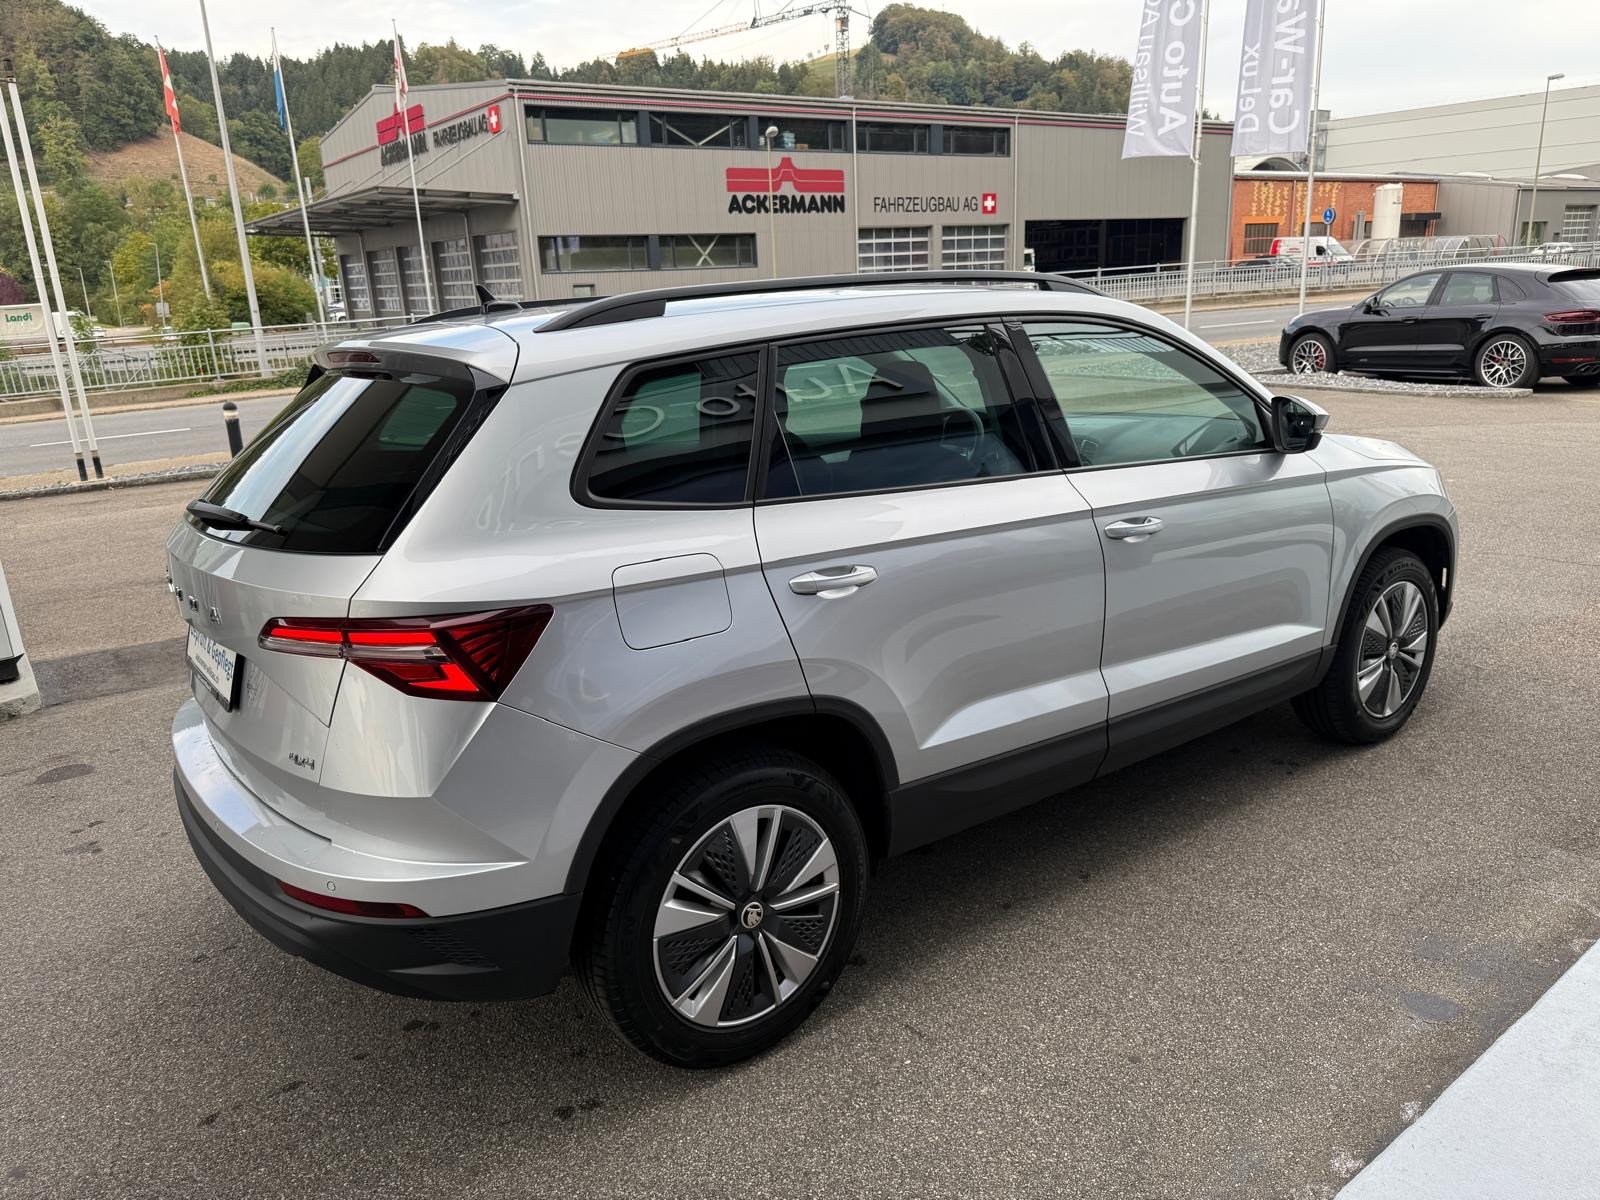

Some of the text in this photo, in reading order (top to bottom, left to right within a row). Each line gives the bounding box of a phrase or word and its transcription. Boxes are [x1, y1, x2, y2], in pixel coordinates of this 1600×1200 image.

[728, 194, 845, 215] ACKERMANN
[873, 196, 979, 213] FAHRZEUGBAU AG
[4, 312, 33, 323] Landi
